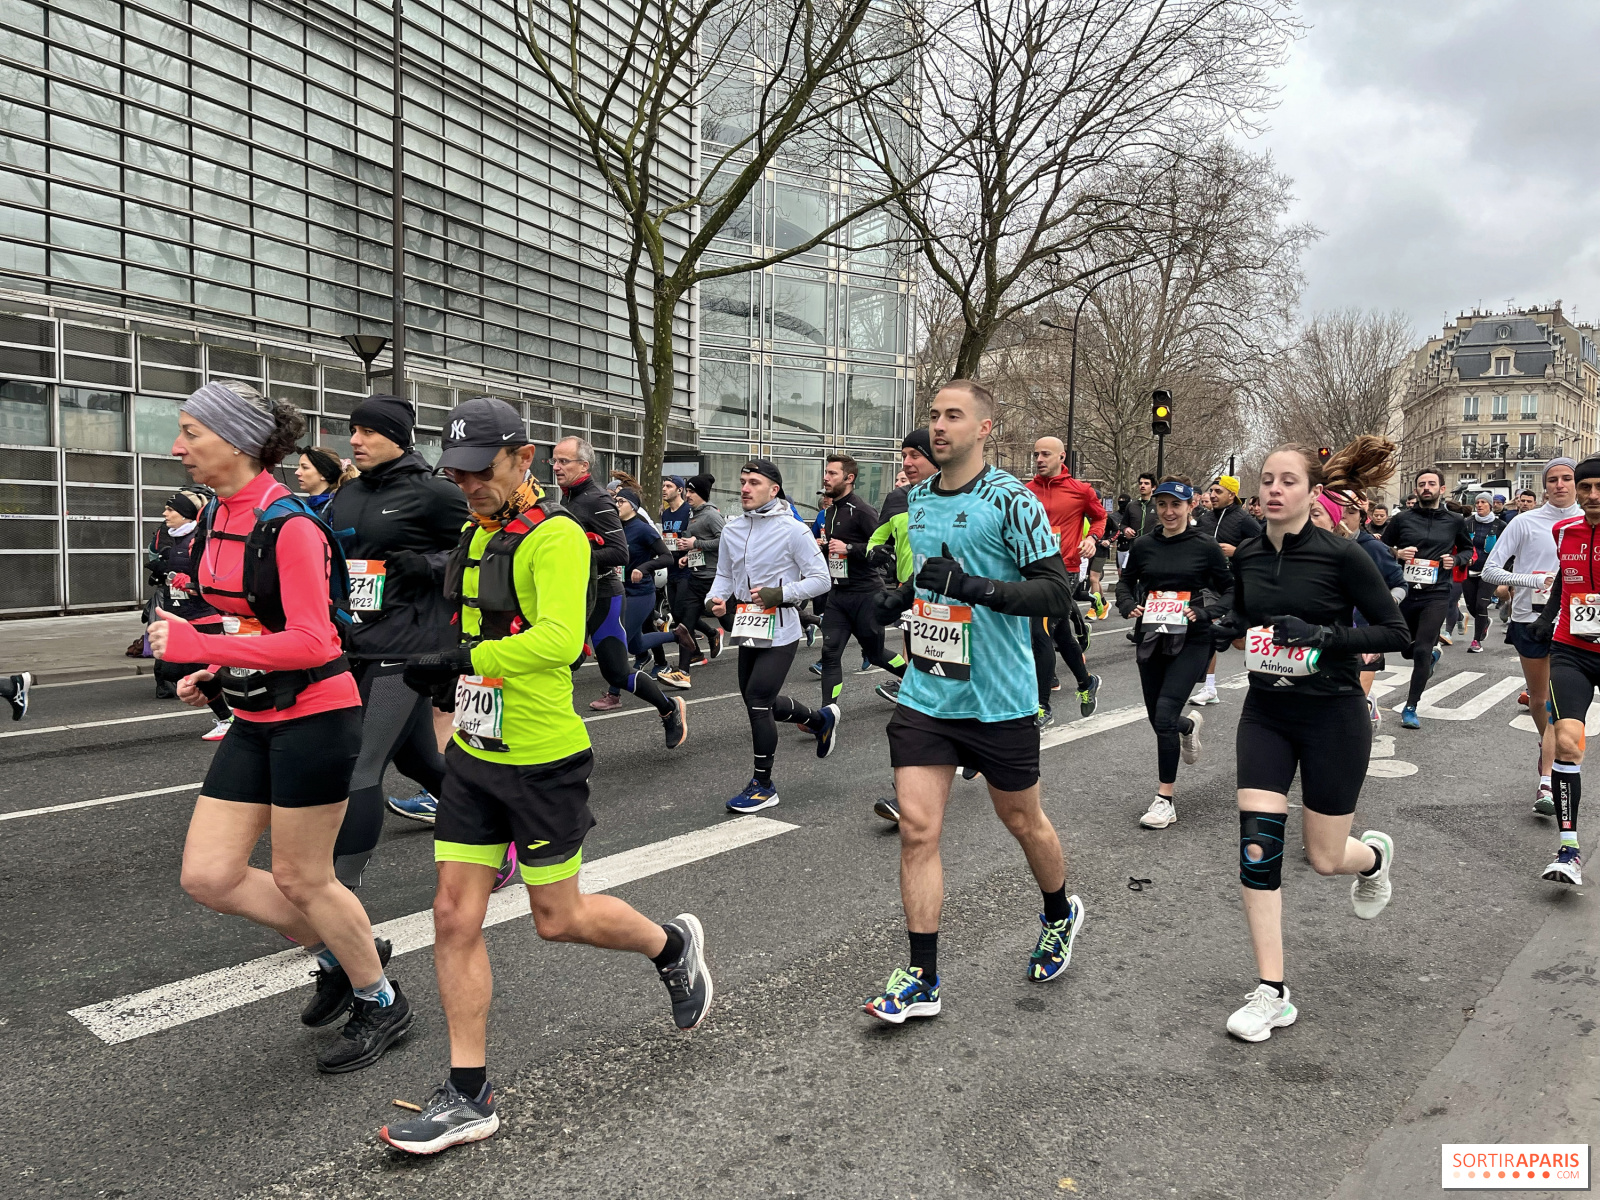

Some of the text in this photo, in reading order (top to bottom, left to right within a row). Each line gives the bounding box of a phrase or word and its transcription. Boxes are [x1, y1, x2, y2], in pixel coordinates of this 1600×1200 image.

[1406, 566, 1433, 577] 11538
[1147, 601, 1183, 614] 38930
[736, 615, 770, 628] 32927
[913, 620, 962, 646] 32204
[924, 644, 946, 659] Aitor
[1259, 659, 1294, 674] Ainhoa
